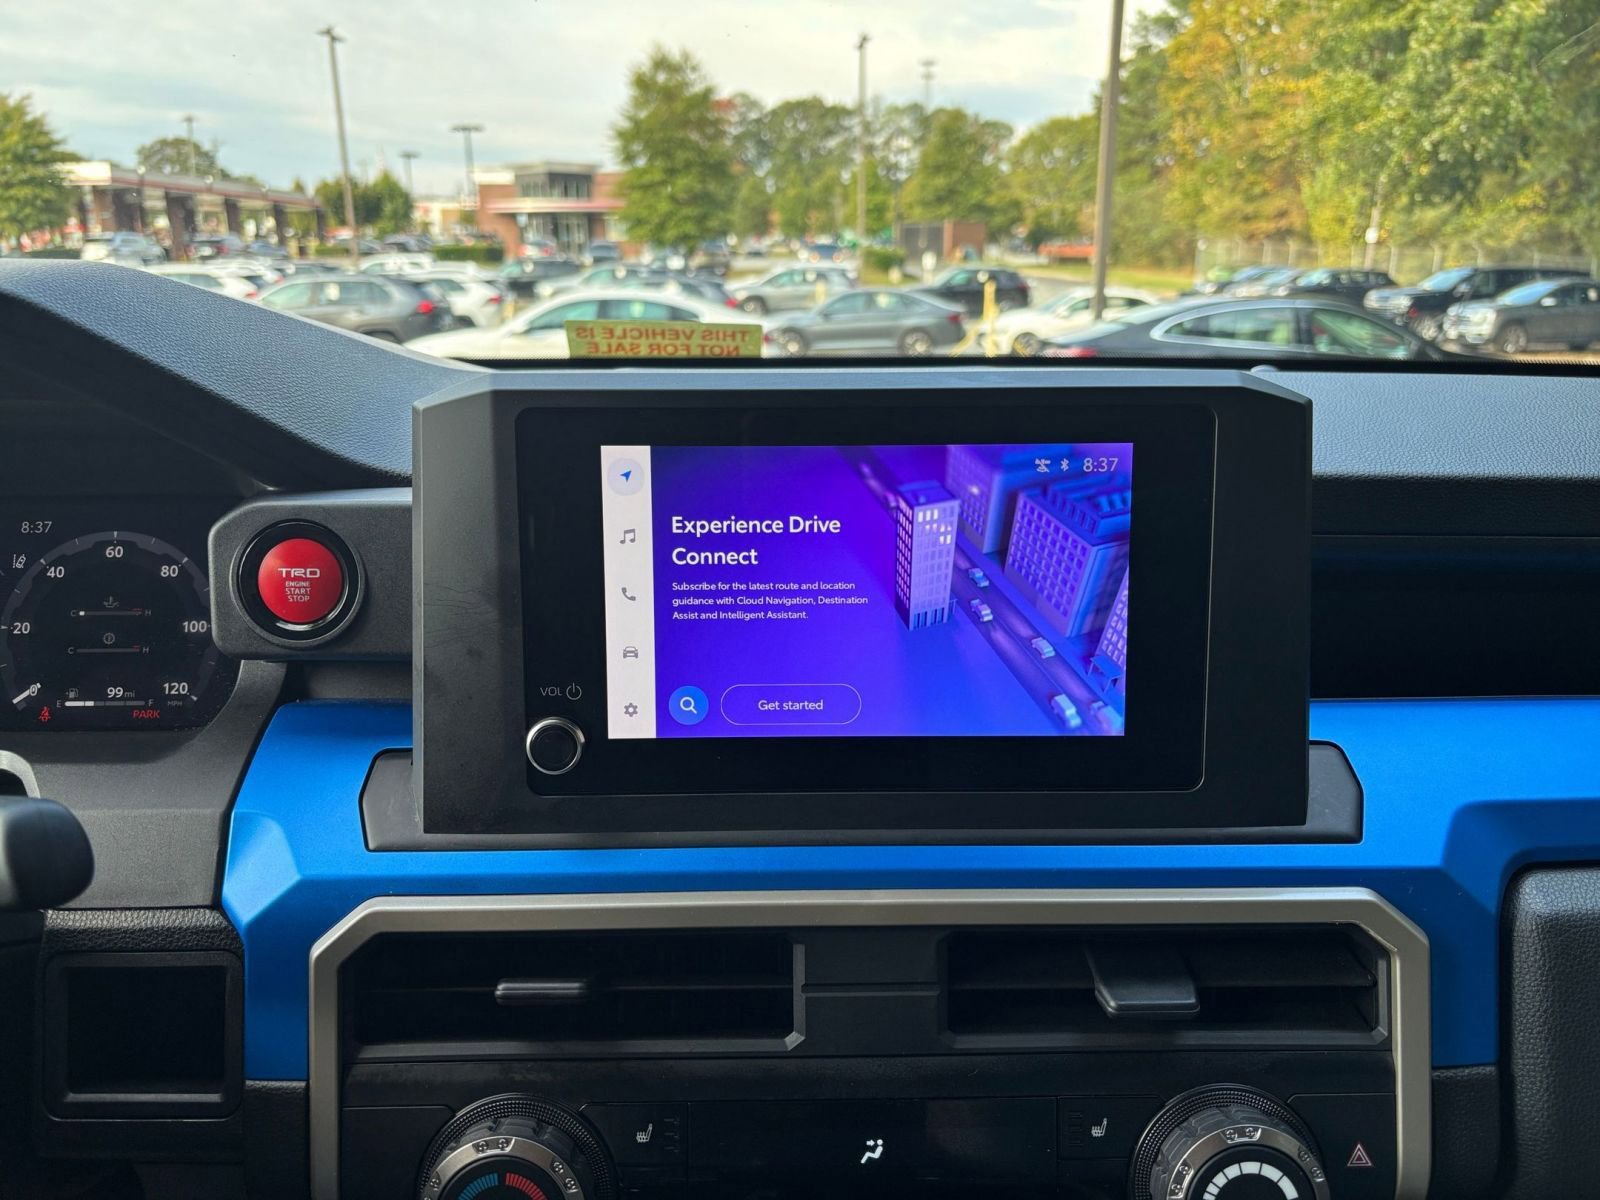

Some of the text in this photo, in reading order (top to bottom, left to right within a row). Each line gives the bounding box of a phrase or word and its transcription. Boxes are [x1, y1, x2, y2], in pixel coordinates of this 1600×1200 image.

[1083, 458, 1119, 472] 8:37
[20, 520, 53, 534] 8:37
[671, 515, 841, 538] Experience Drive
[105, 546, 124, 558] 60
[671, 547, 759, 566] Connect
[46, 566, 65, 578] 40
[160, 565, 179, 577] 80
[277, 567, 321, 578] TRD
[285, 580, 310, 588] ENGINE
[672, 581, 856, 591] Subscribe for the latest route and location
[285, 587, 312, 595] START
[287, 594, 311, 602] STOP
[672, 596, 869, 607] guidance with Cloud Navigation, Destination
[70, 609, 152, 617] C H
[672, 610, 809, 621] Assist and Intelligent Assistant.
[12, 622, 31, 634] 20
[182, 620, 208, 633] 100
[106, 686, 136, 698] 99 mi
[162, 682, 189, 695] 120
[540, 685, 562, 697] VOL
[56, 700, 62, 708] E
[757, 698, 824, 712] Get started
[132, 709, 161, 719] PARK
